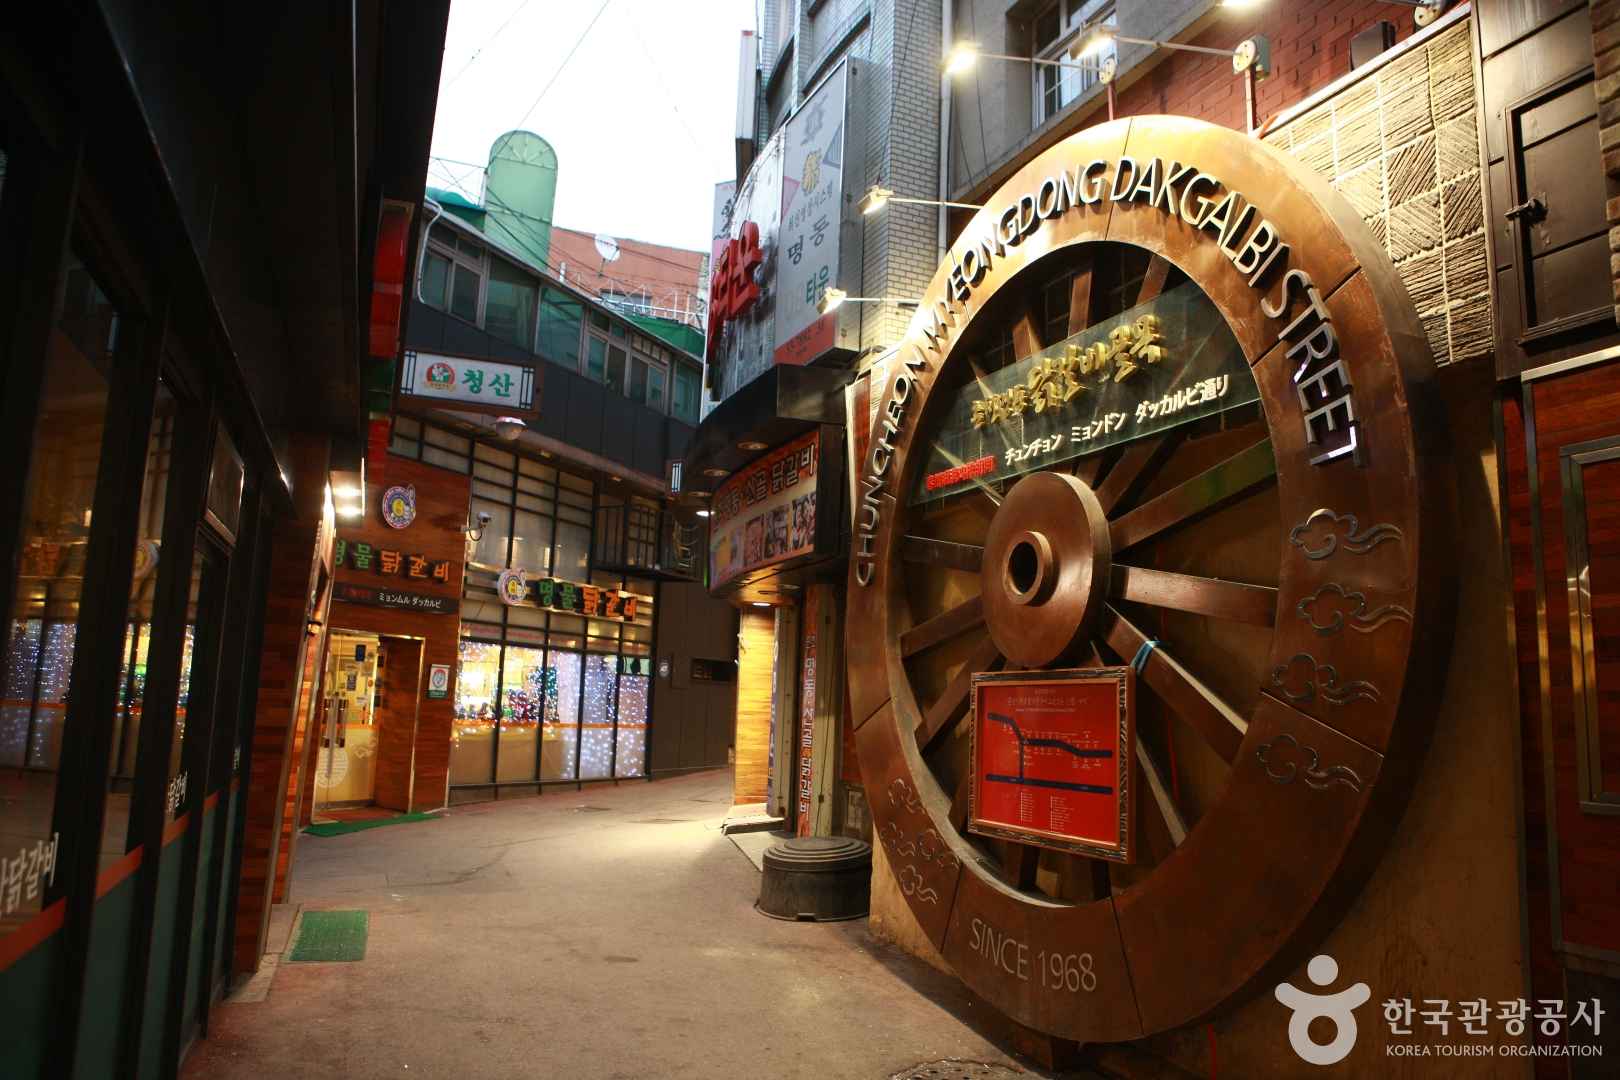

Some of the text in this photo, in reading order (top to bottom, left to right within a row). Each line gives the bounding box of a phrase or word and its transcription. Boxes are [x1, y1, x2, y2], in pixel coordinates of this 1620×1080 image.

[462, 368, 515, 398] 청산
[855, 345, 927, 588] CHUNCHEON
[1109, 156, 1290, 287] DAKGALBI
[1261, 270, 1364, 468] STREET
[1071, 411, 1127, 442] ミョンドン
[1136, 373, 1230, 424] ダッカルビ通り
[771, 443, 816, 493] 닭갈비
[968, 917, 1098, 993] SINCE 1968
